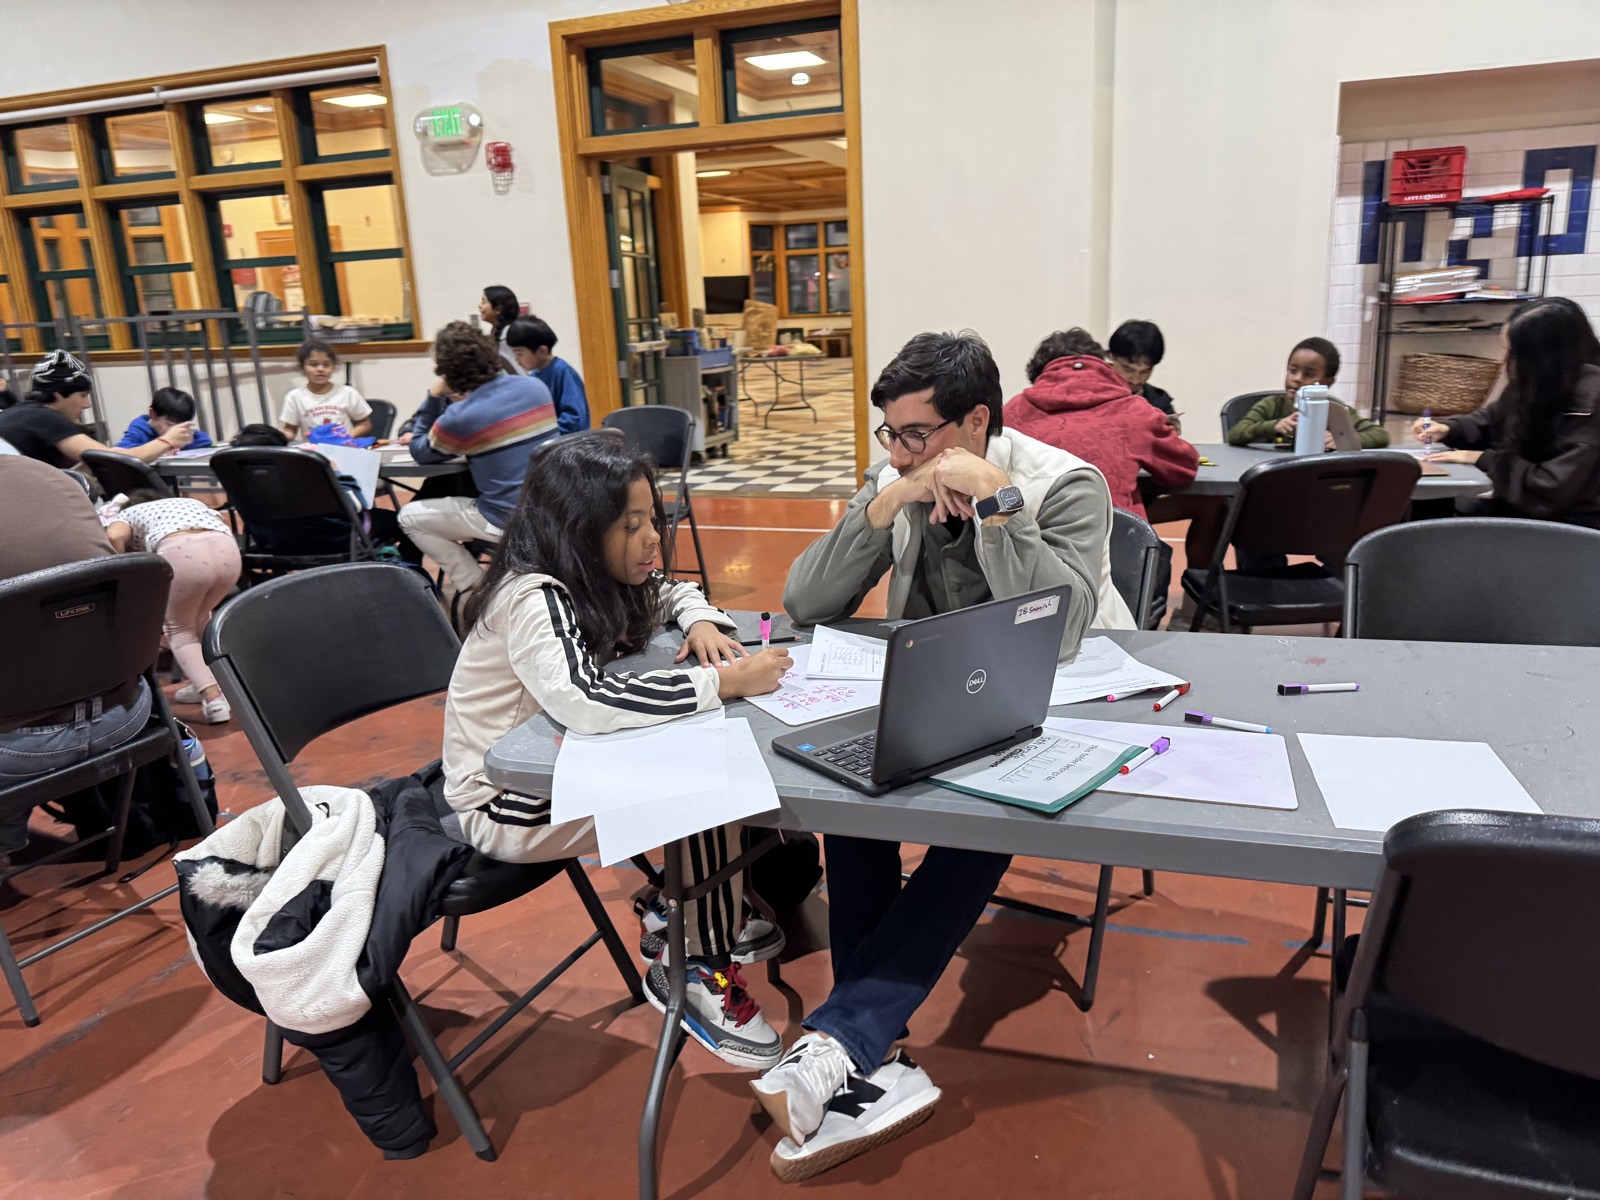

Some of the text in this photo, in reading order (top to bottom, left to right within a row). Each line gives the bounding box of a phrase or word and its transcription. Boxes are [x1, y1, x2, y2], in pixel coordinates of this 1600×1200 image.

[1073, 749, 1088, 765] folder
[1088, 743, 1099, 755] This
[1052, 762, 1073, 779] belongs
